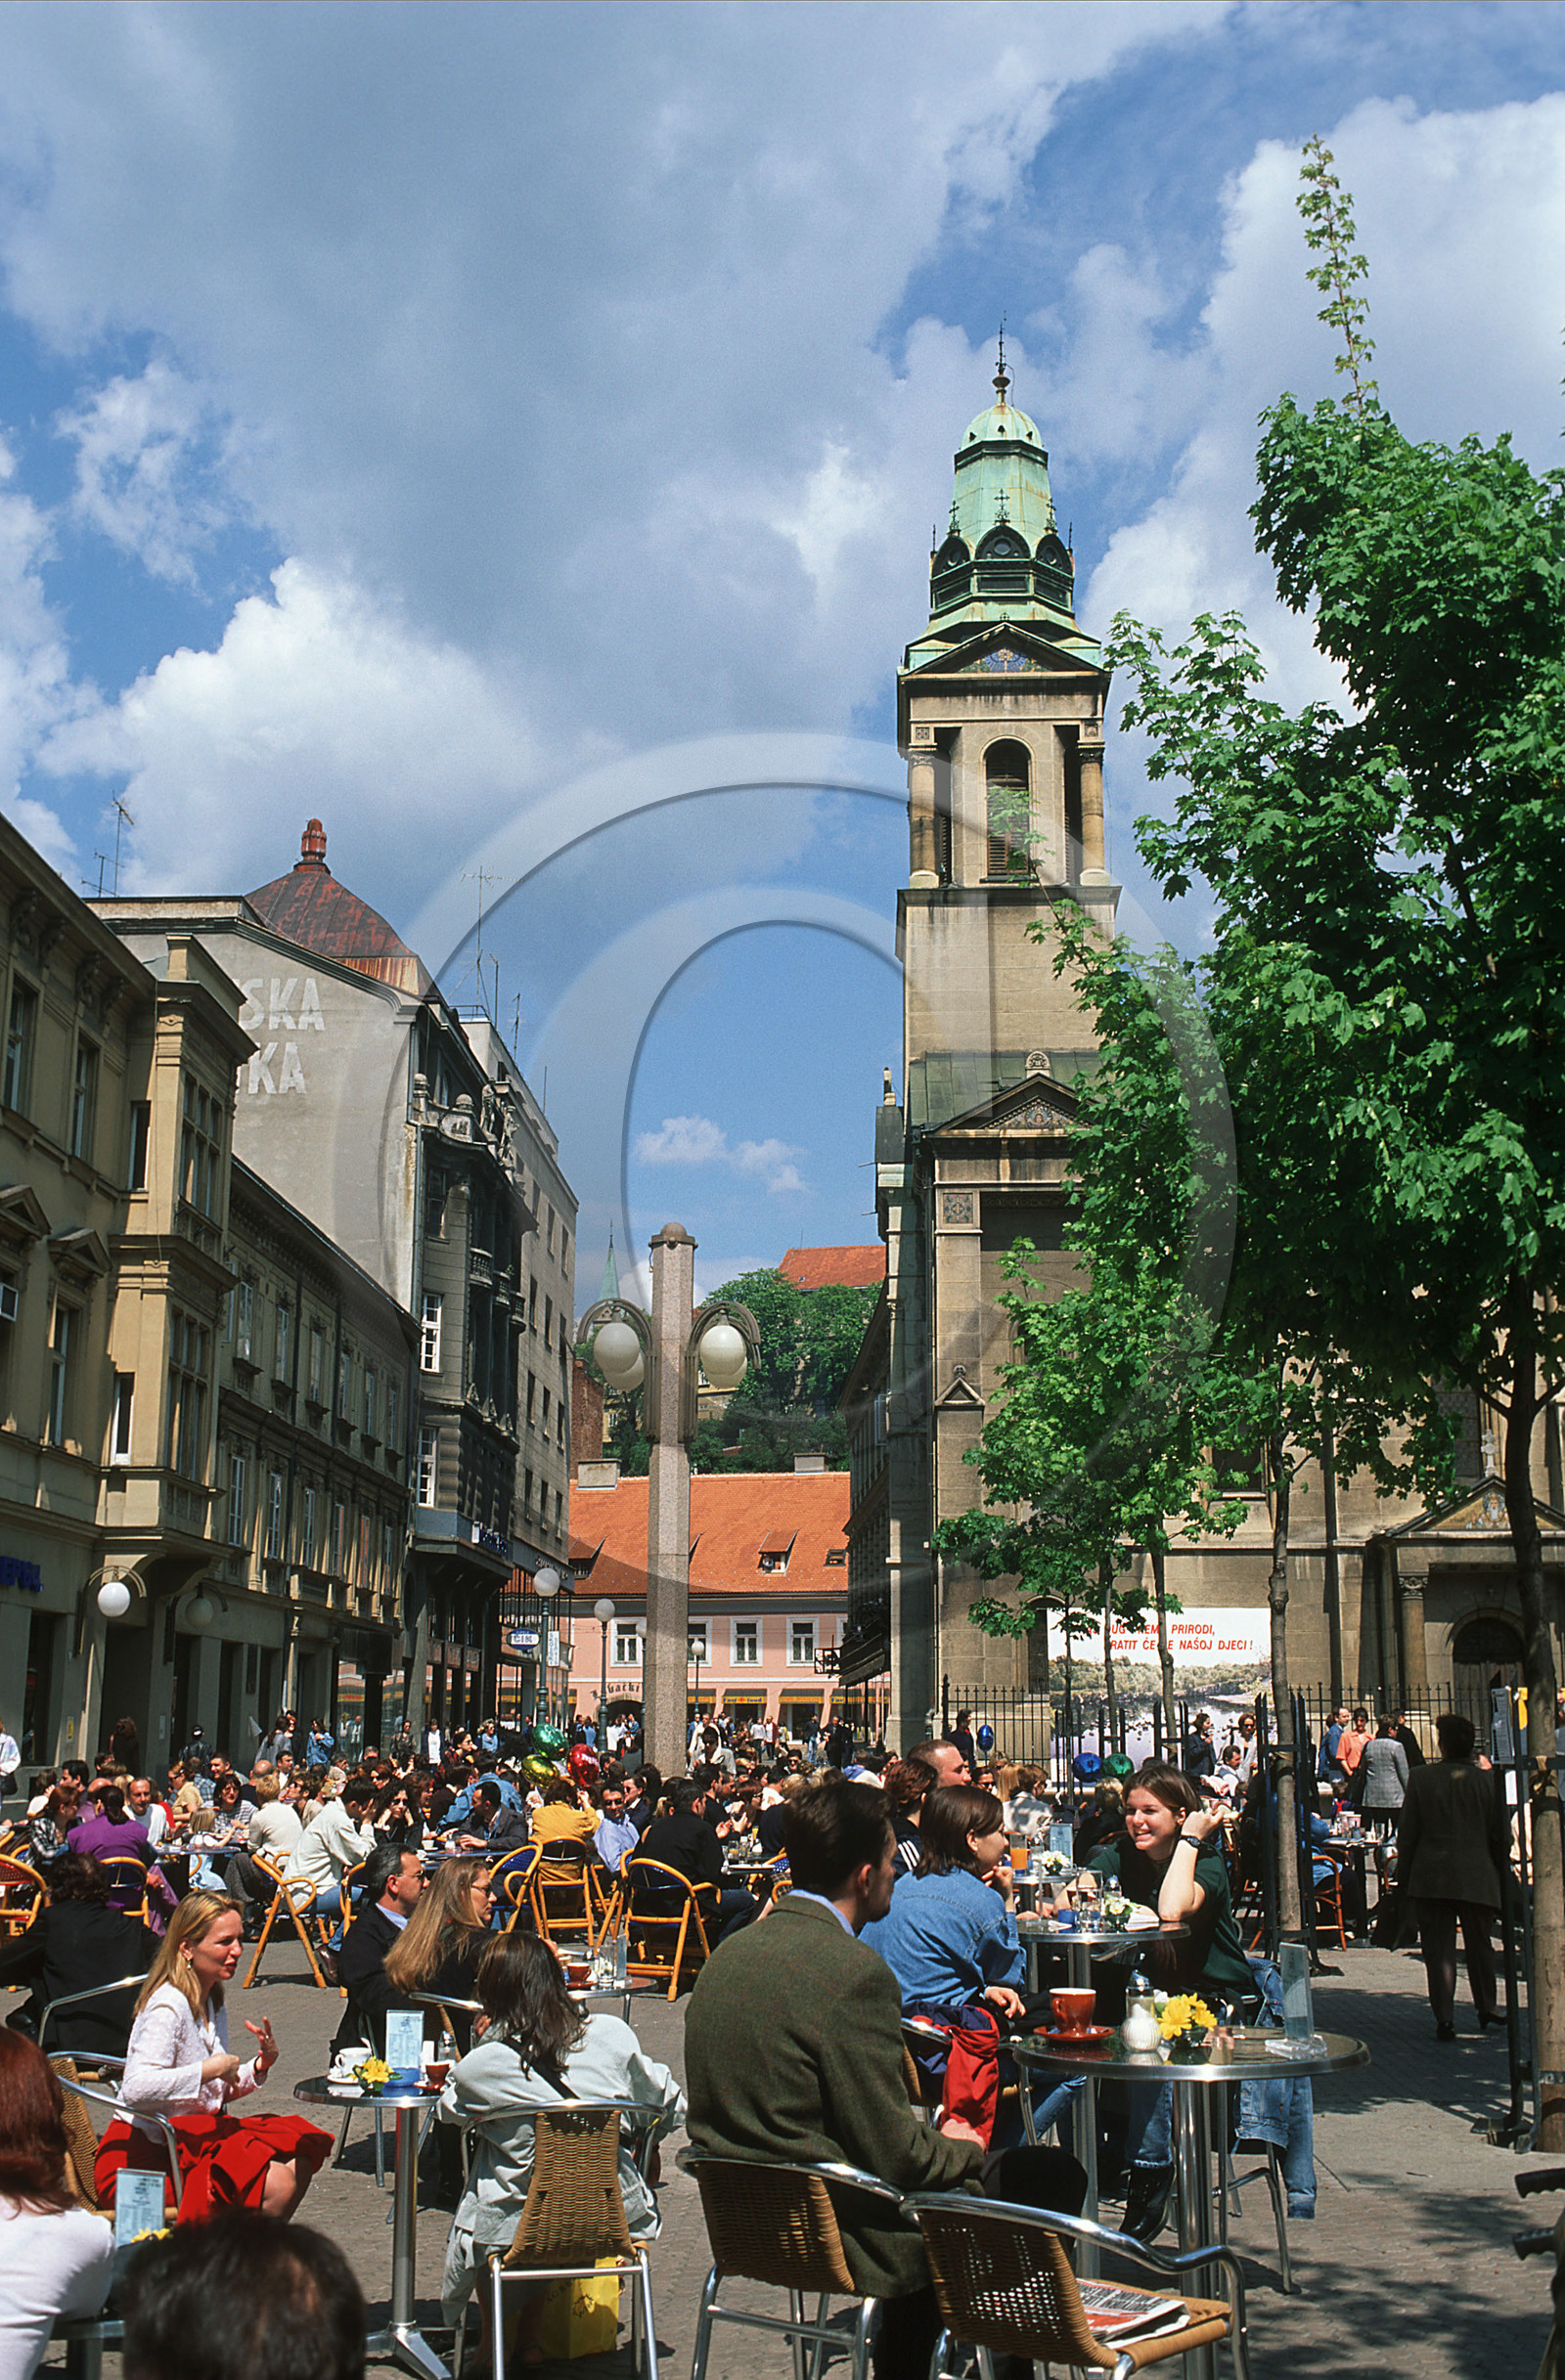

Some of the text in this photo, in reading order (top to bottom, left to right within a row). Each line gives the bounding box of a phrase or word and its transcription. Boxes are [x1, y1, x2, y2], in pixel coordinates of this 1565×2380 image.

[234, 978, 326, 1031] SKA
[238, 1042, 307, 1094] KA
[1110, 1624, 1126, 1634] UG
[1171, 1624, 1215, 1636] PRIRODI,
[1110, 1640, 1138, 1650] RATIT
